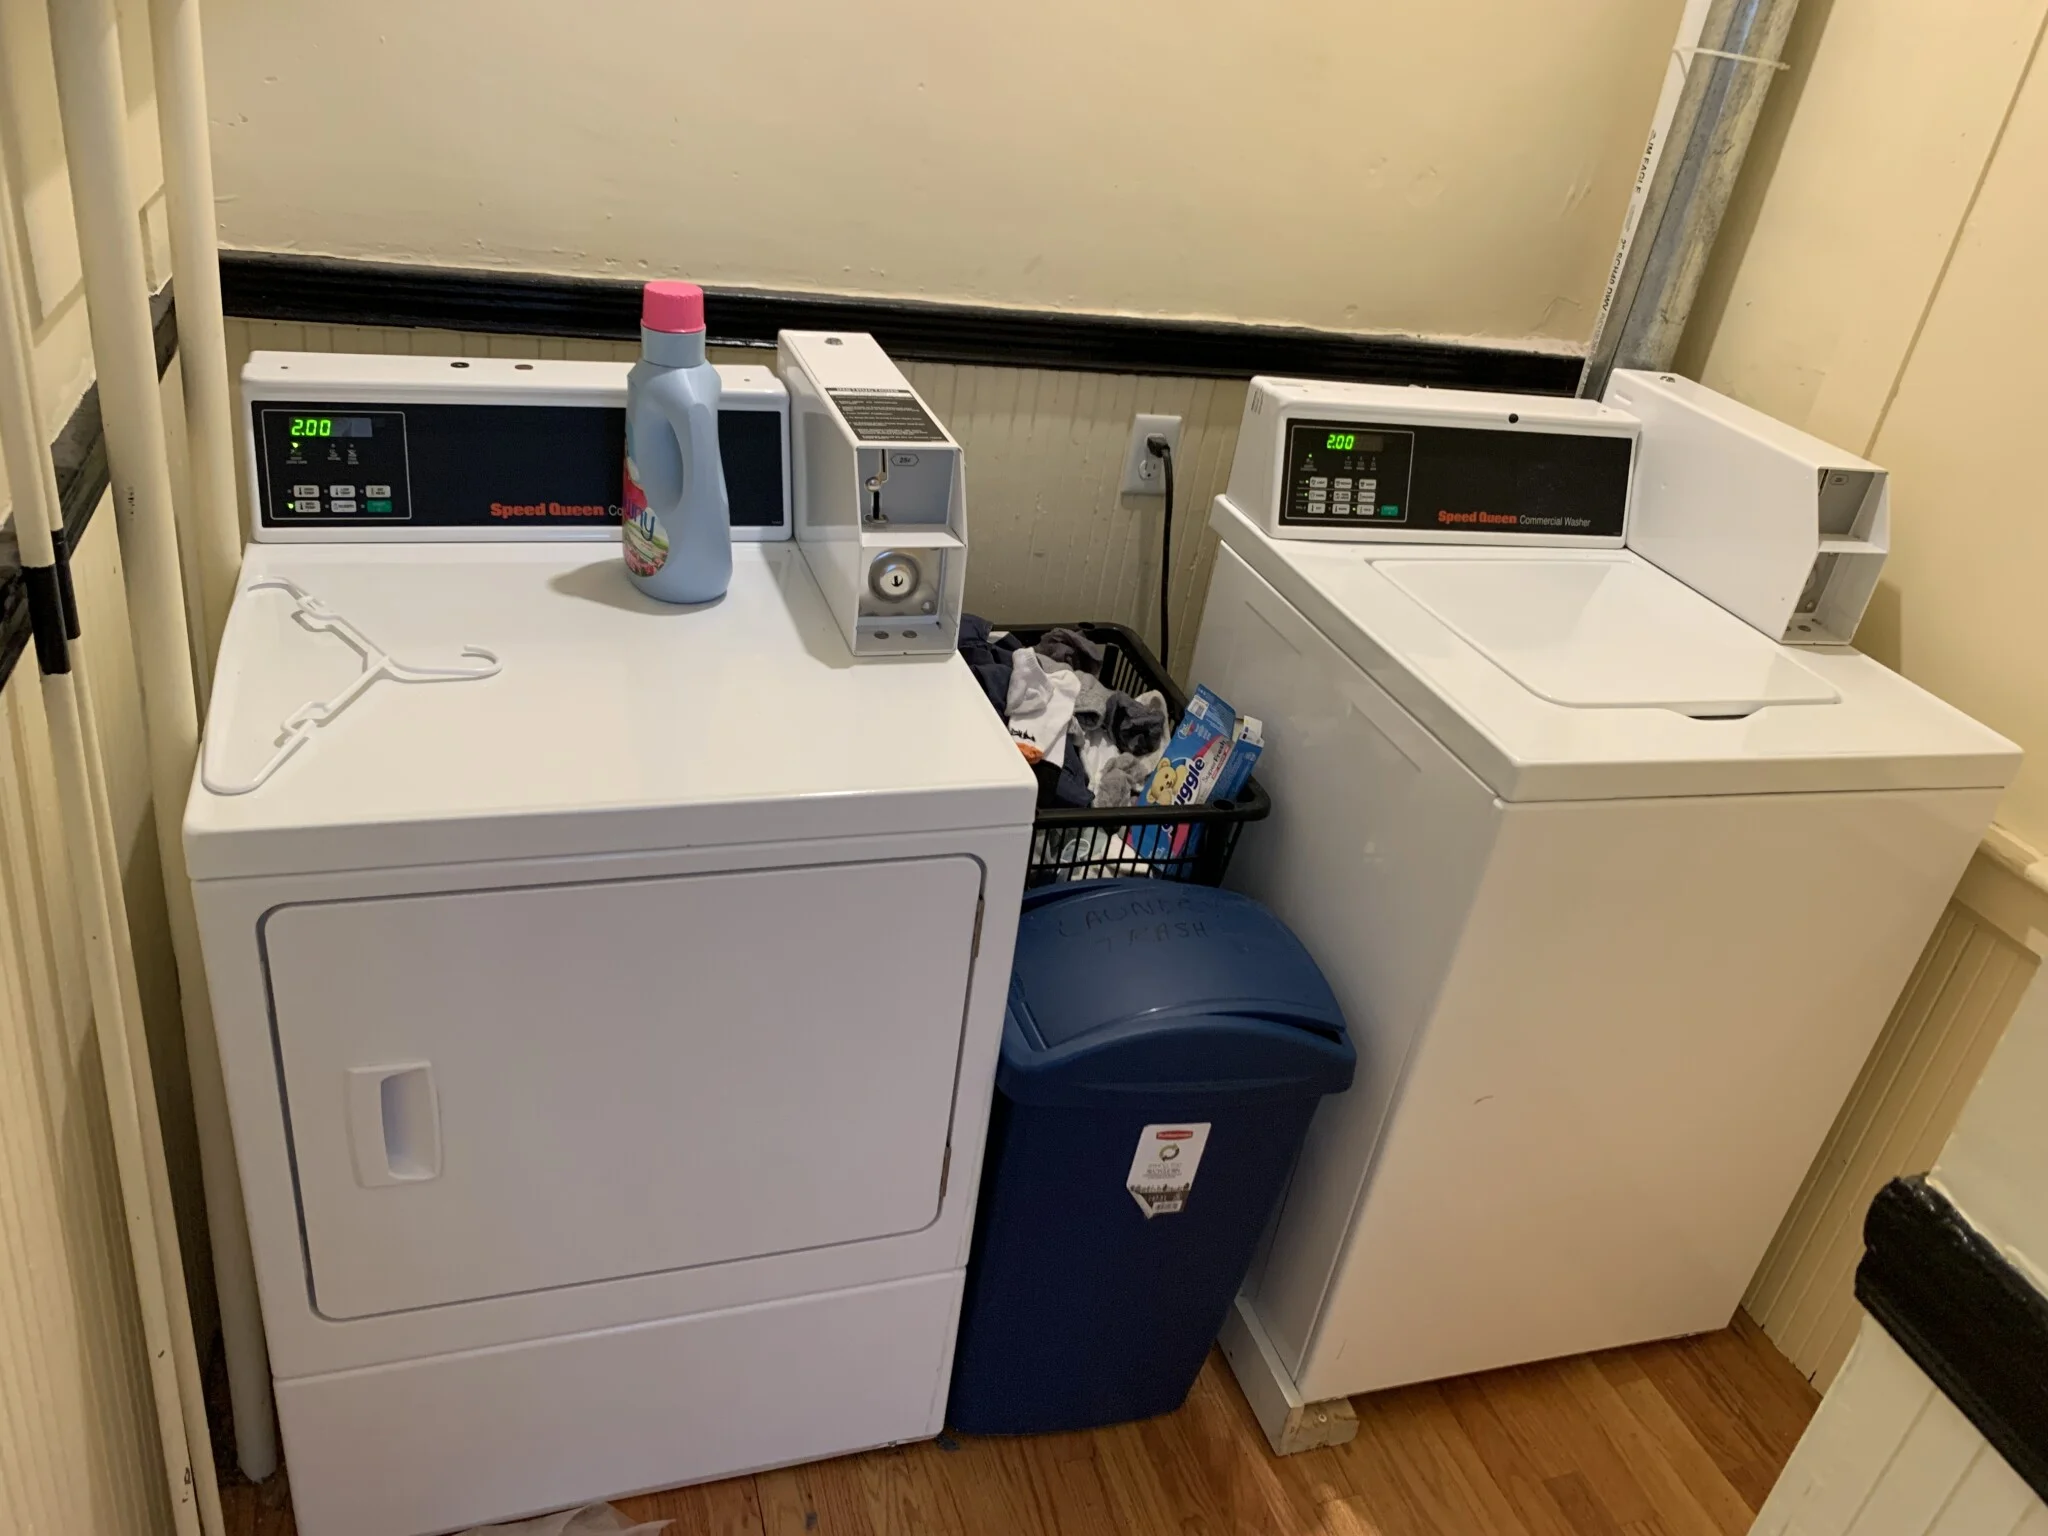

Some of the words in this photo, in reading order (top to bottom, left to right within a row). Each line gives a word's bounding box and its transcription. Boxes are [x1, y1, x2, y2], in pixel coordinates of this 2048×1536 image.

[291, 419, 331, 436] 2.00
[1327, 434, 1355, 450] 2.00
[490, 502, 546, 519] Speed
[549, 502, 604, 517] Queen
[1438, 510, 1477, 524] Speed
[1479, 511, 1517, 524] Queen
[1519, 514, 1563, 526] Commercial
[1564, 516, 1591, 527] Washer
[1174, 758, 1205, 806] uggle
